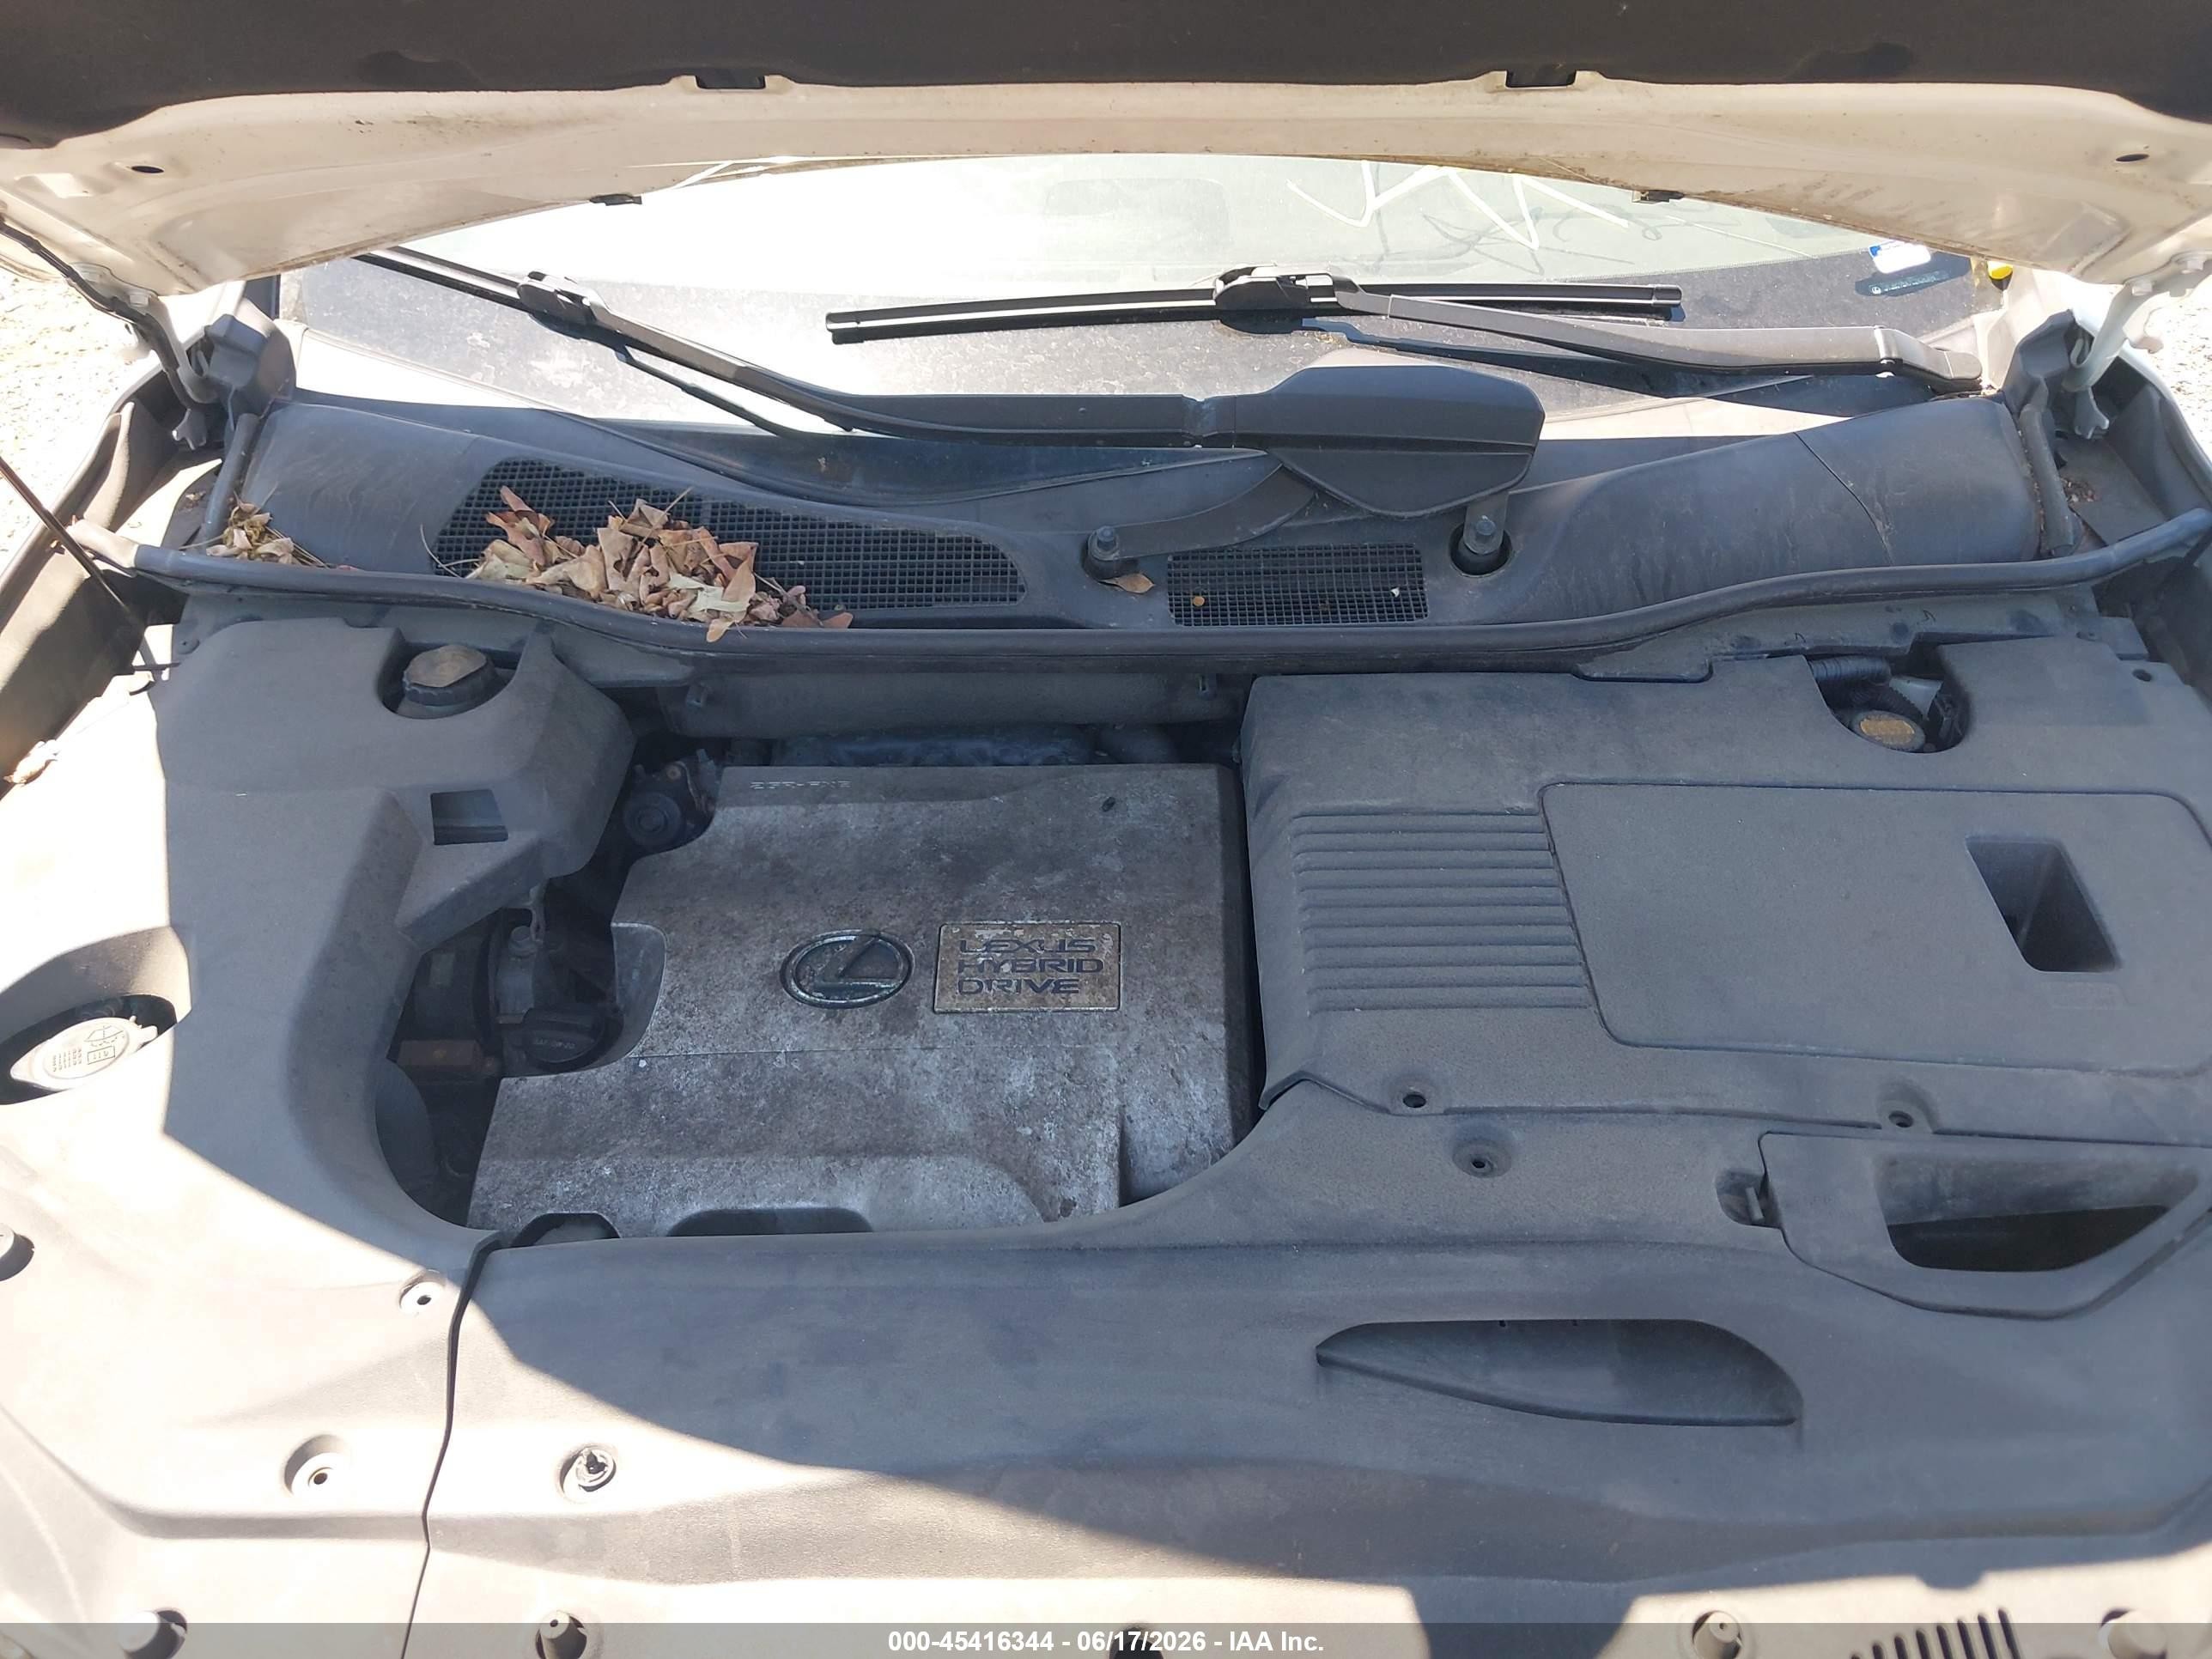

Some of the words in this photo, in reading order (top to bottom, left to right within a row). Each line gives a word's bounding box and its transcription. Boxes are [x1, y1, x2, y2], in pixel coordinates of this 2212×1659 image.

[958, 939, 1097, 954] LEXUS
[957, 958, 1104, 974] HYBRID
[957, 978, 1080, 995] DRIVE
